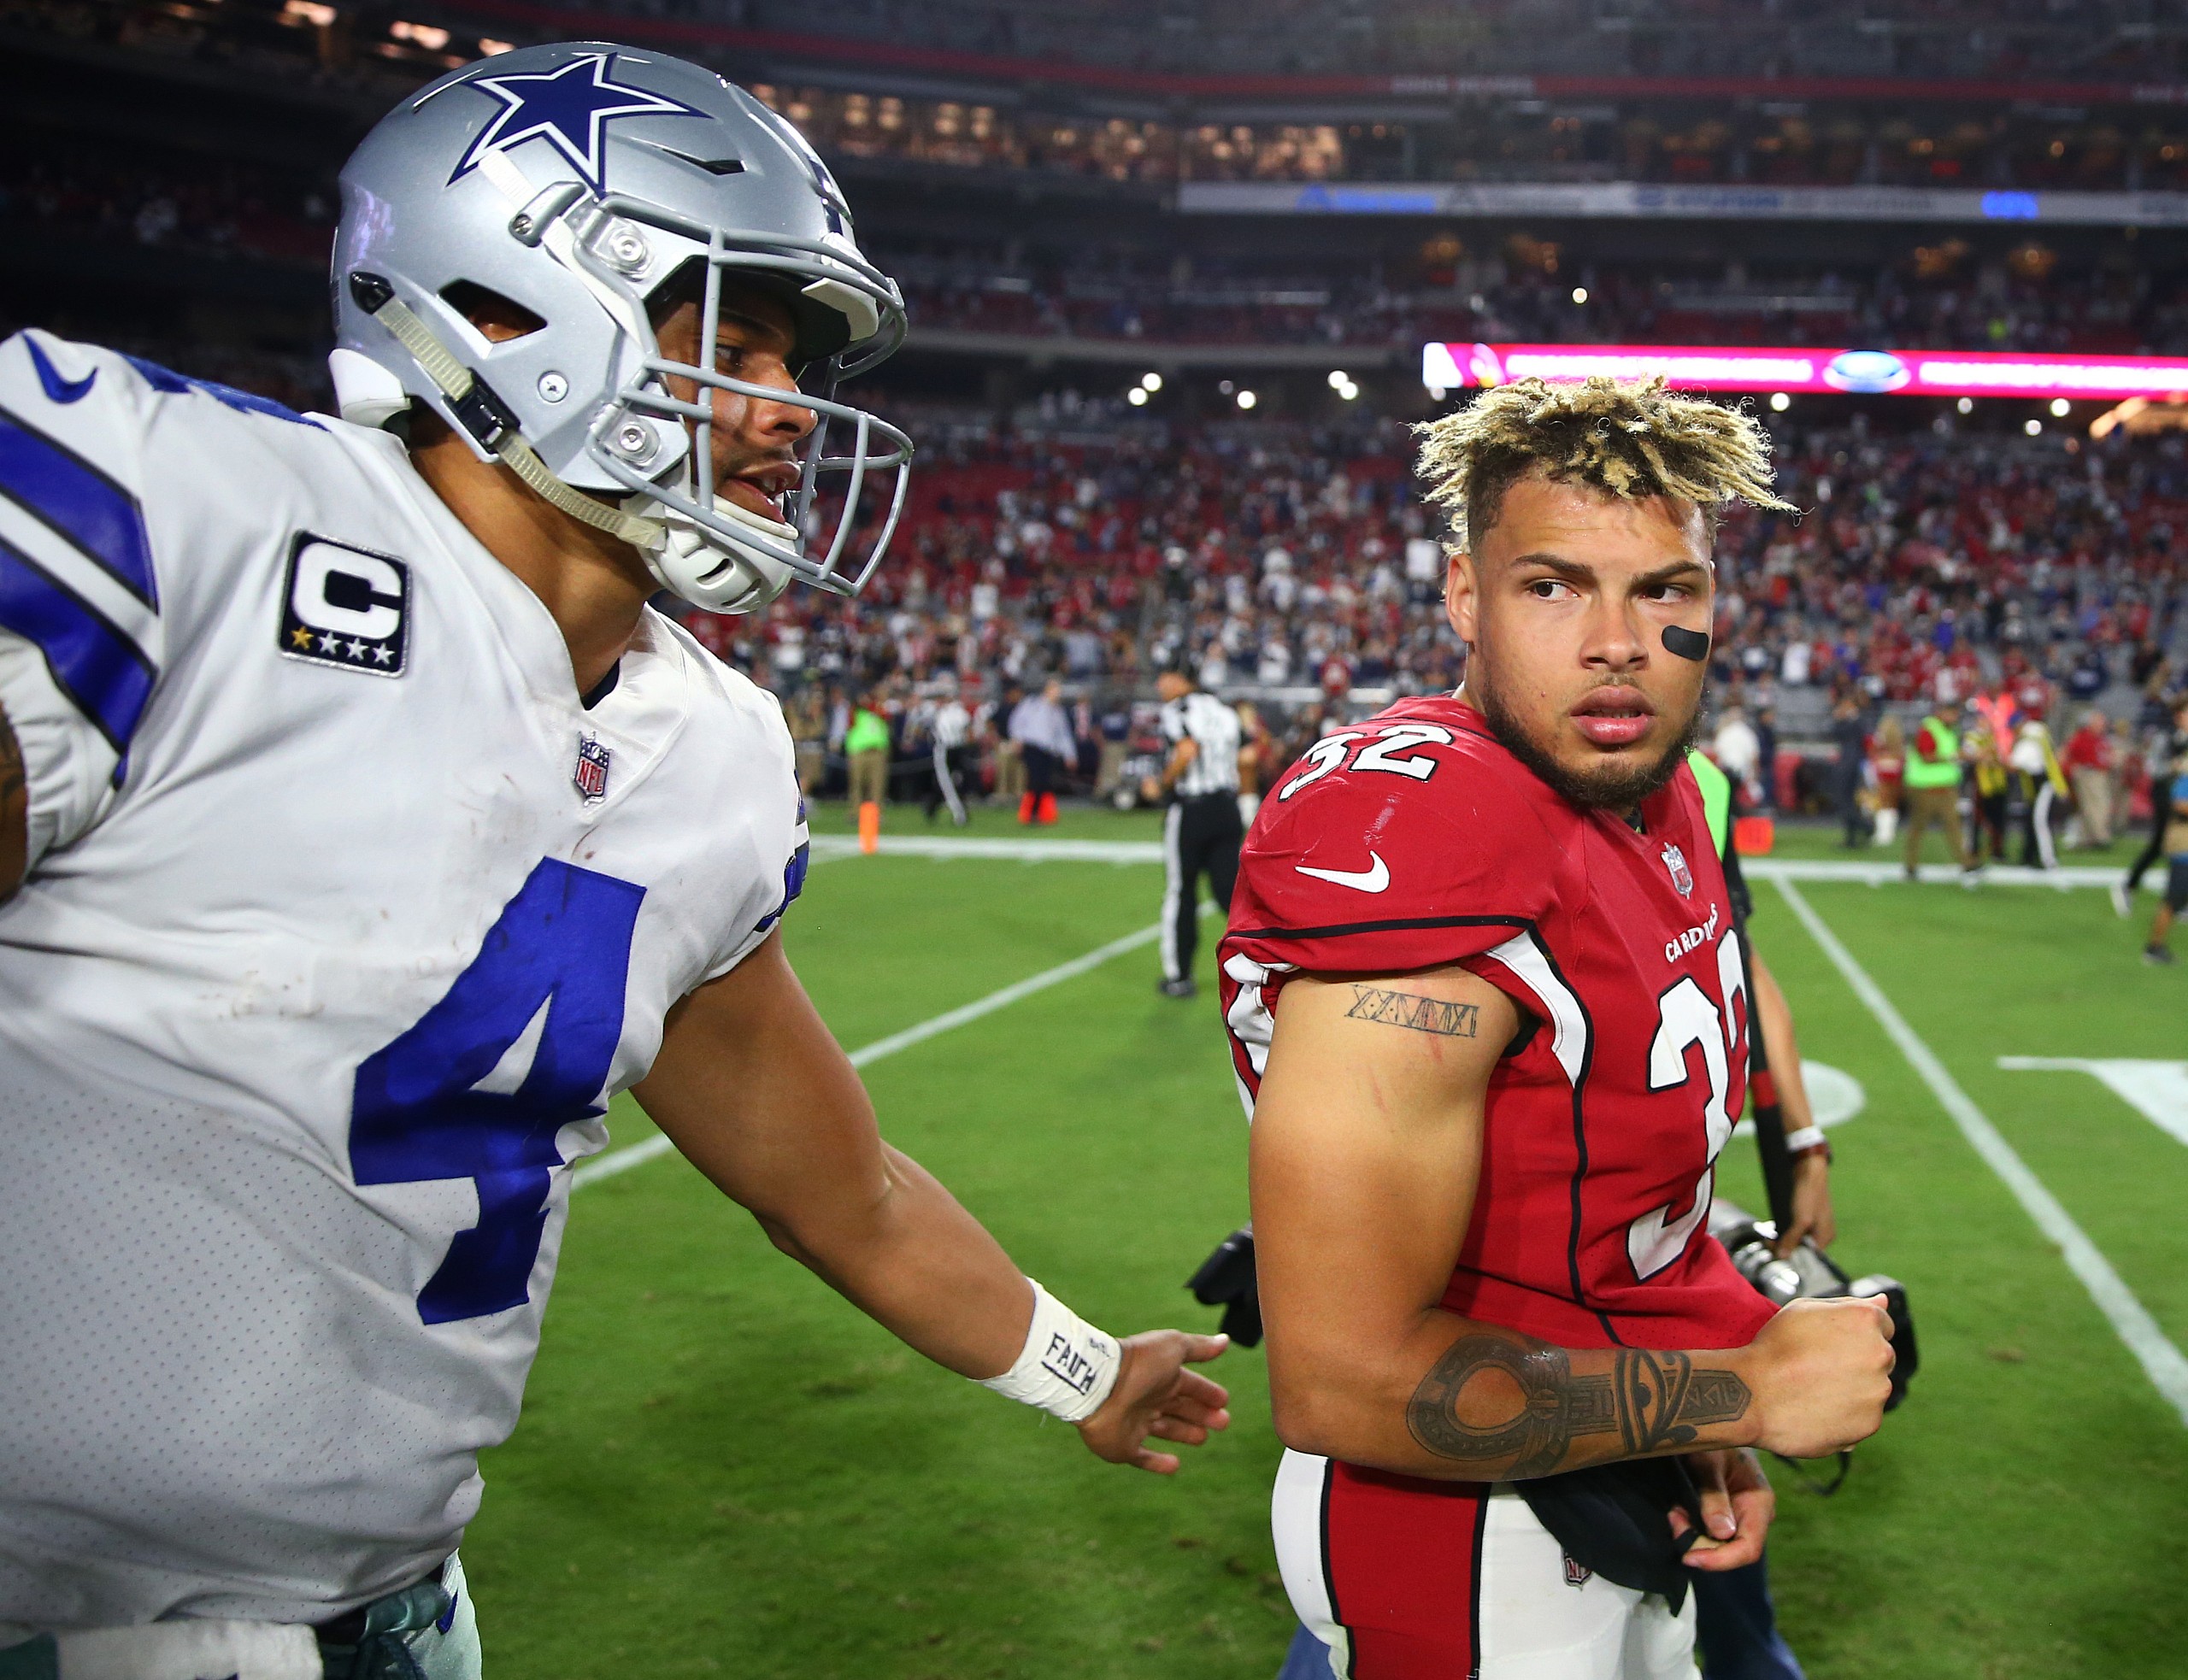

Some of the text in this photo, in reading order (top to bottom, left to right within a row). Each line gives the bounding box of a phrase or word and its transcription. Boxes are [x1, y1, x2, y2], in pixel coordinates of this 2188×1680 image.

[291, 542, 402, 640] C
[576, 758, 603, 793] NFL
[1278, 724, 1456, 802] 32
[348, 855, 647, 1326] 4
[1044, 1331, 1097, 1392] FAITH
